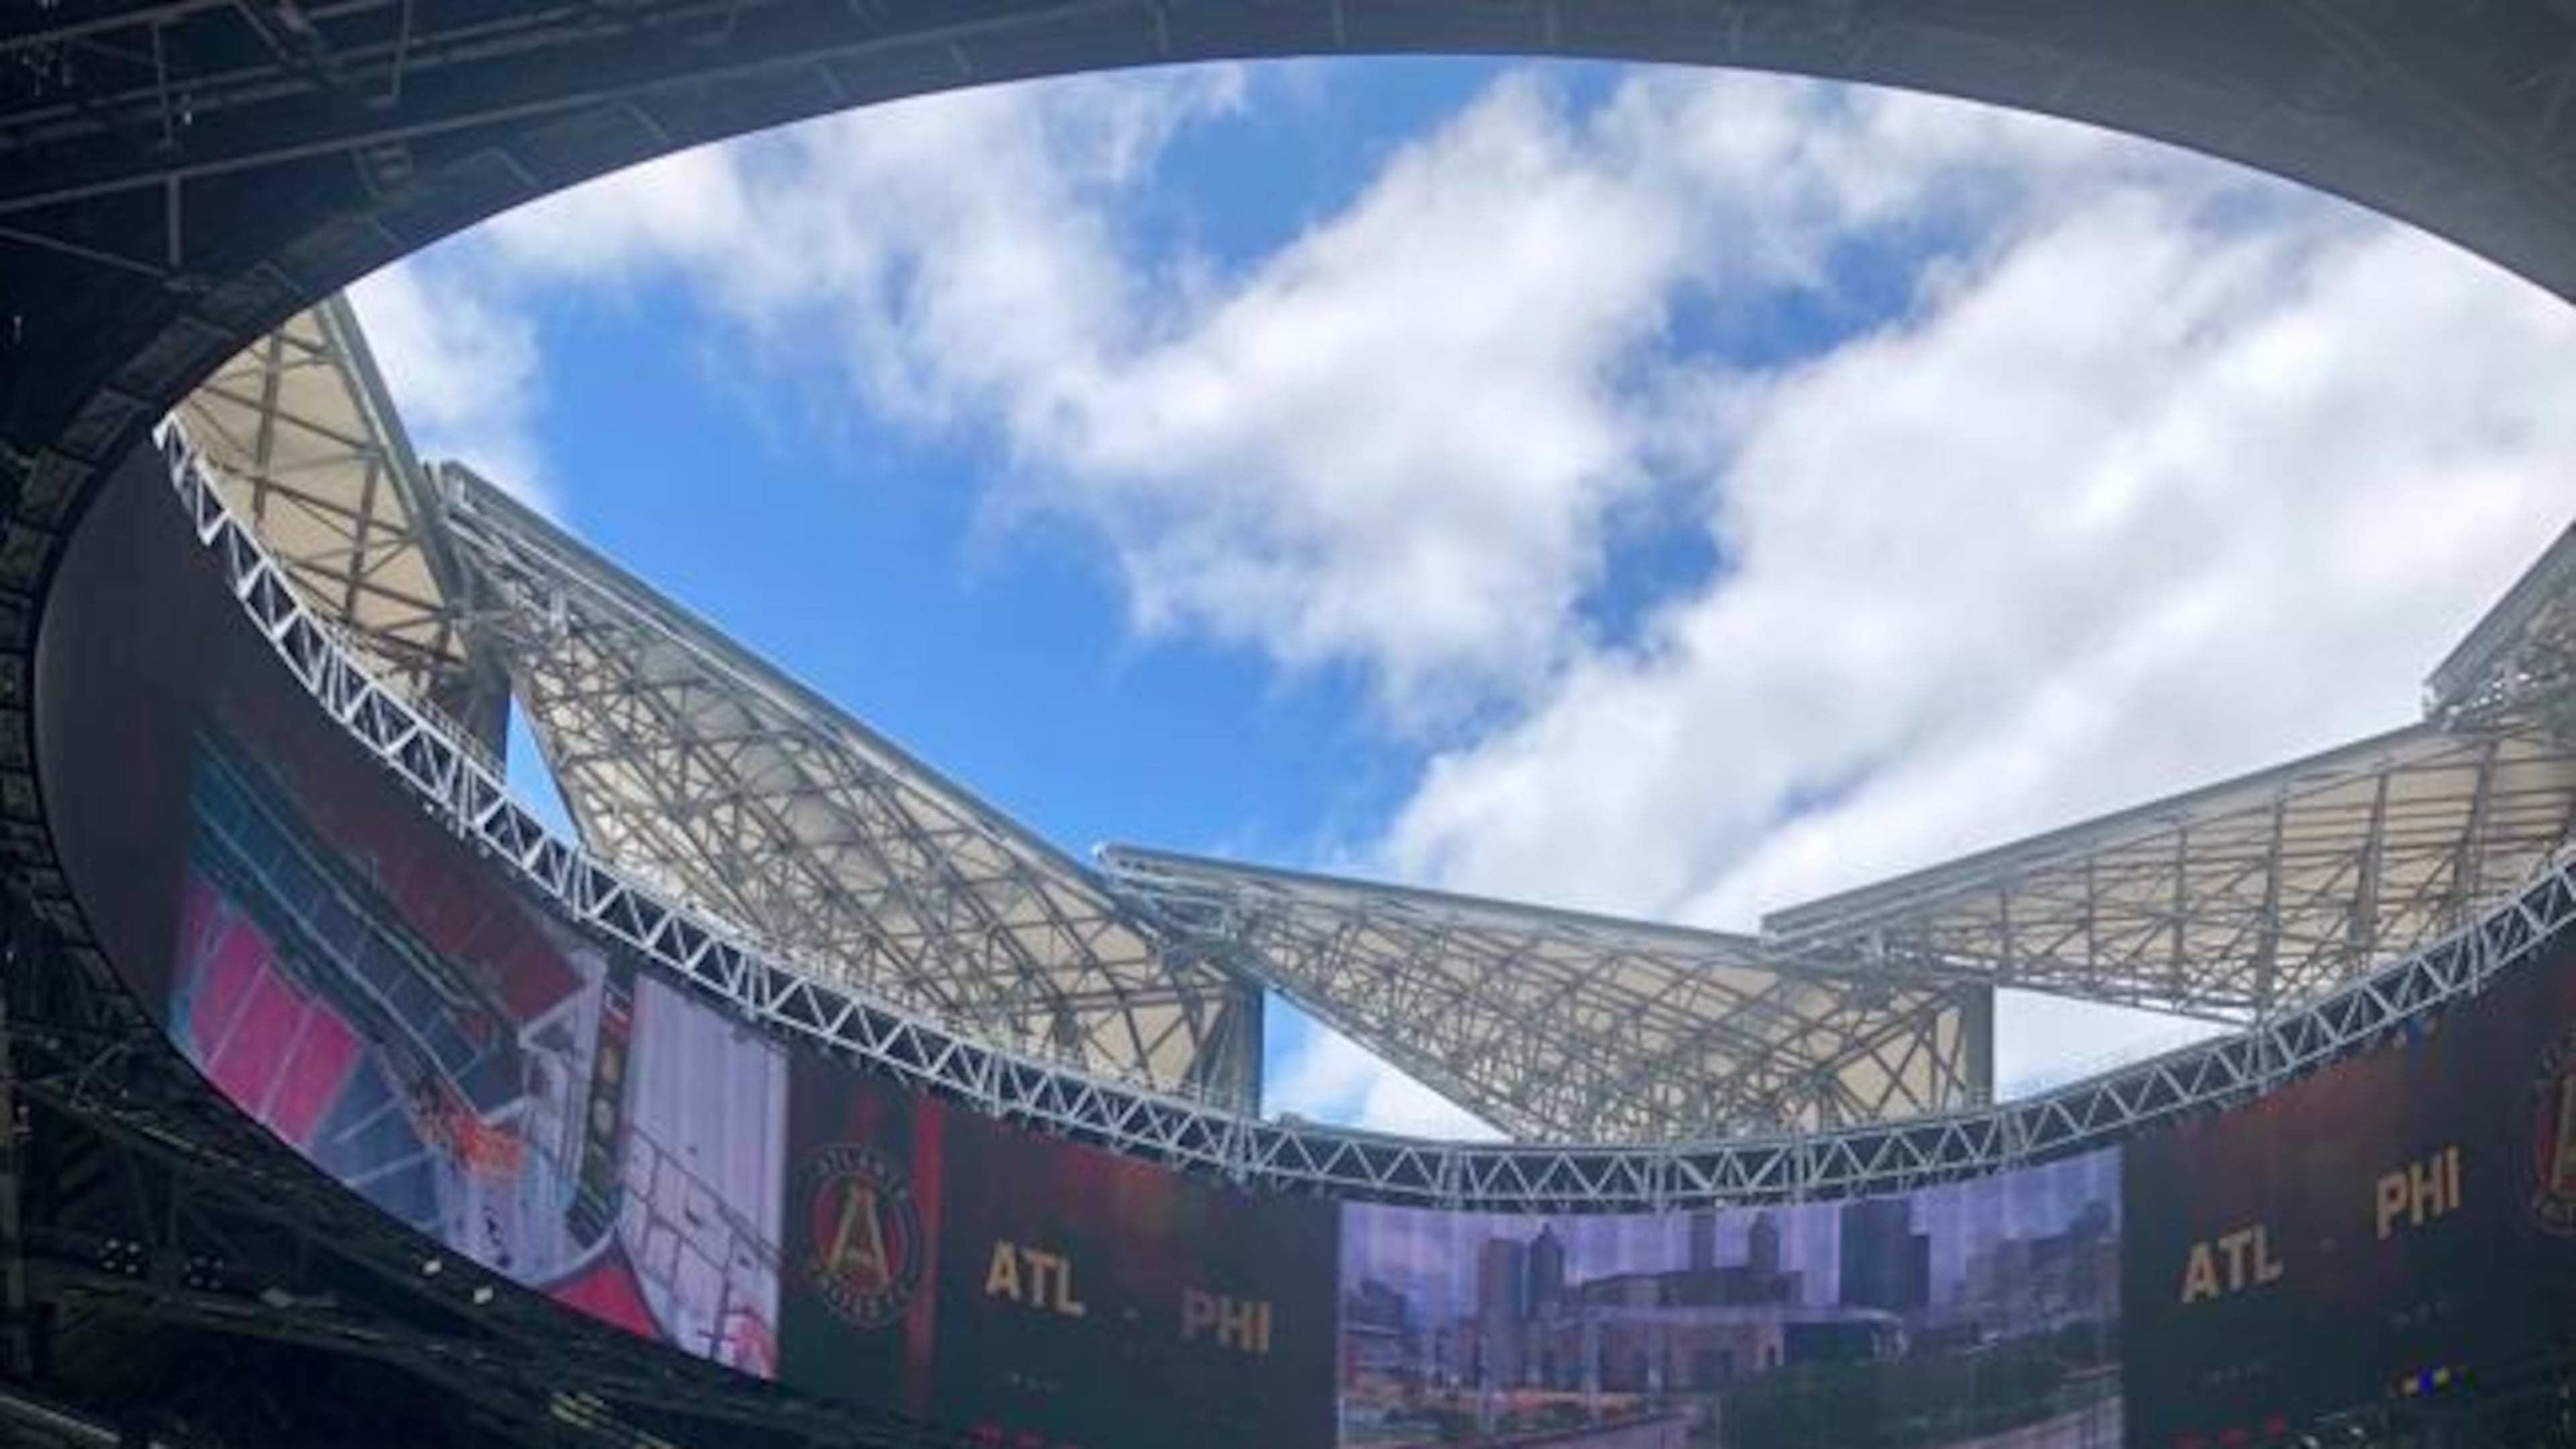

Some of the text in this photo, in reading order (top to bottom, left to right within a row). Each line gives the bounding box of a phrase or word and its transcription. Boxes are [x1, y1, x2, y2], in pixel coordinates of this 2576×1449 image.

[2180, 1146, 2463, 1304] ATL PHI
[985, 1238, 1087, 1317] ATL
[1181, 1289, 1272, 1355] PHI
